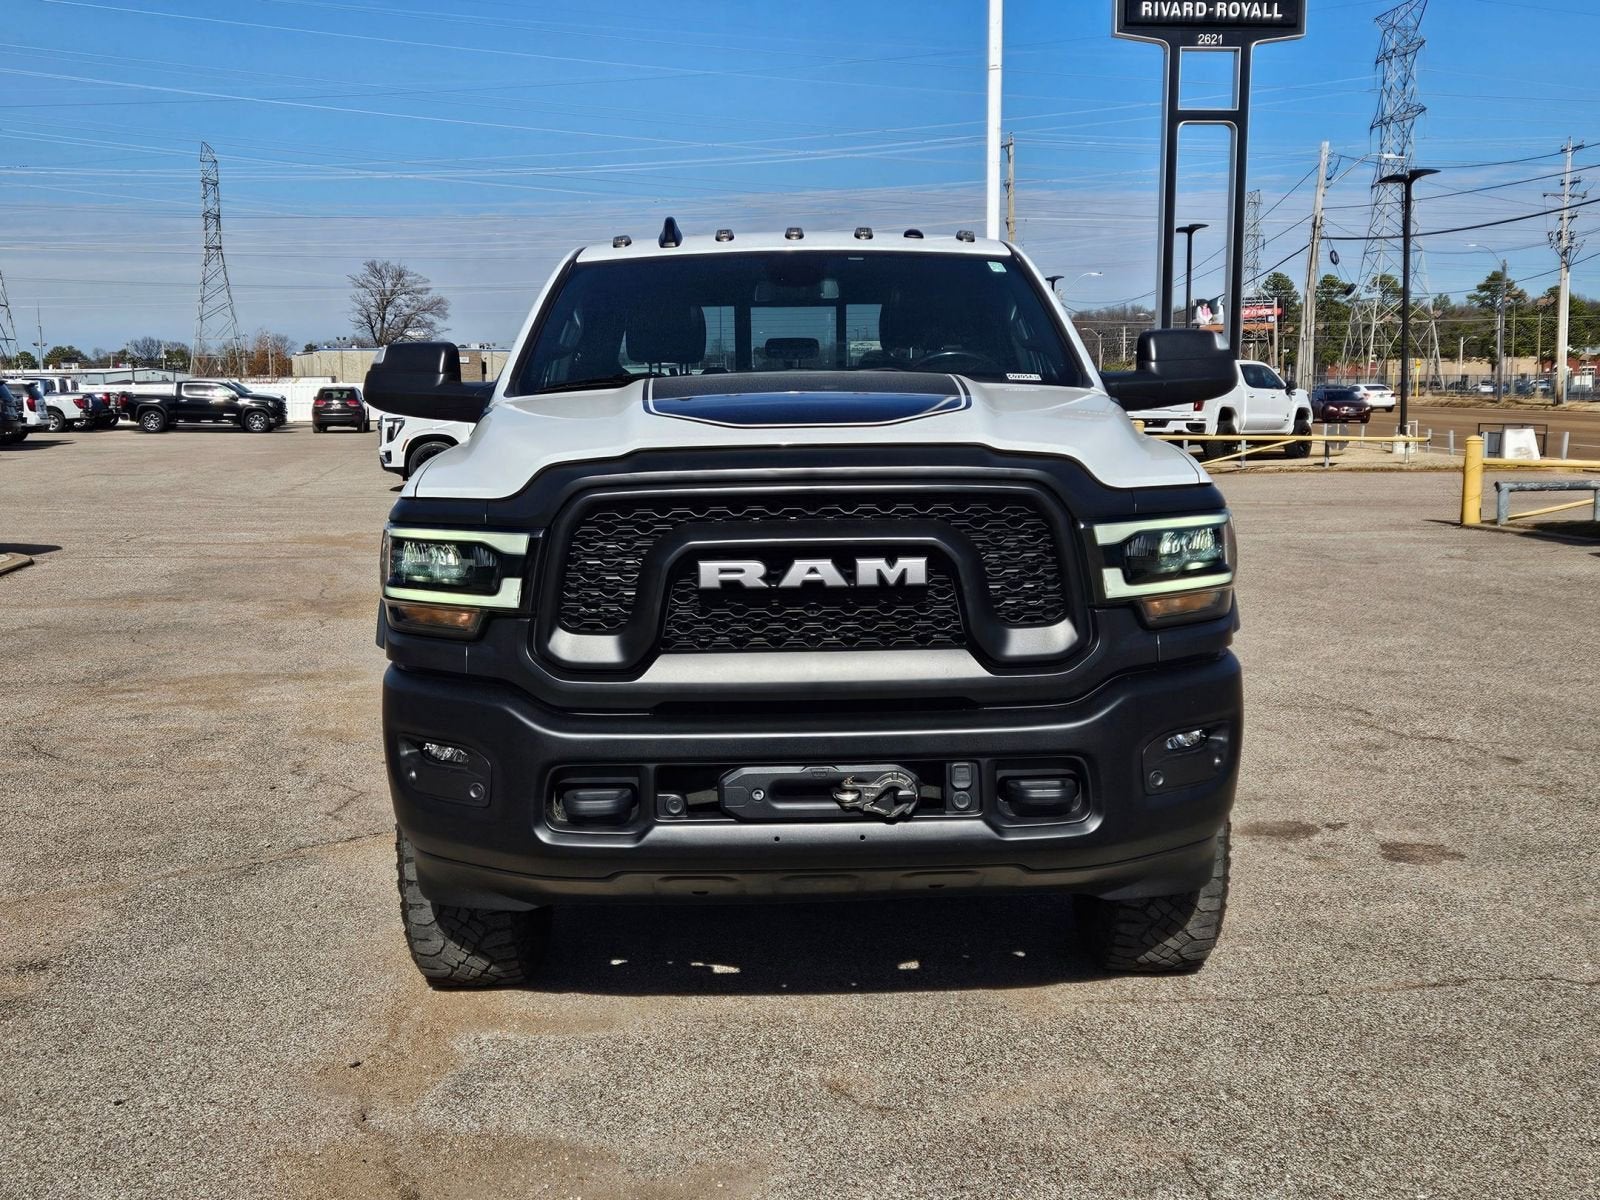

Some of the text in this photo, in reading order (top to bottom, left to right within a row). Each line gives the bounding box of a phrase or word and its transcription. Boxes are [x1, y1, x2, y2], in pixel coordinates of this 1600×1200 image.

[1141, 2, 1283, 18] RIVARD-ROYALL
[1198, 34, 1223, 45] 2621
[698, 557, 927, 588] RAM
